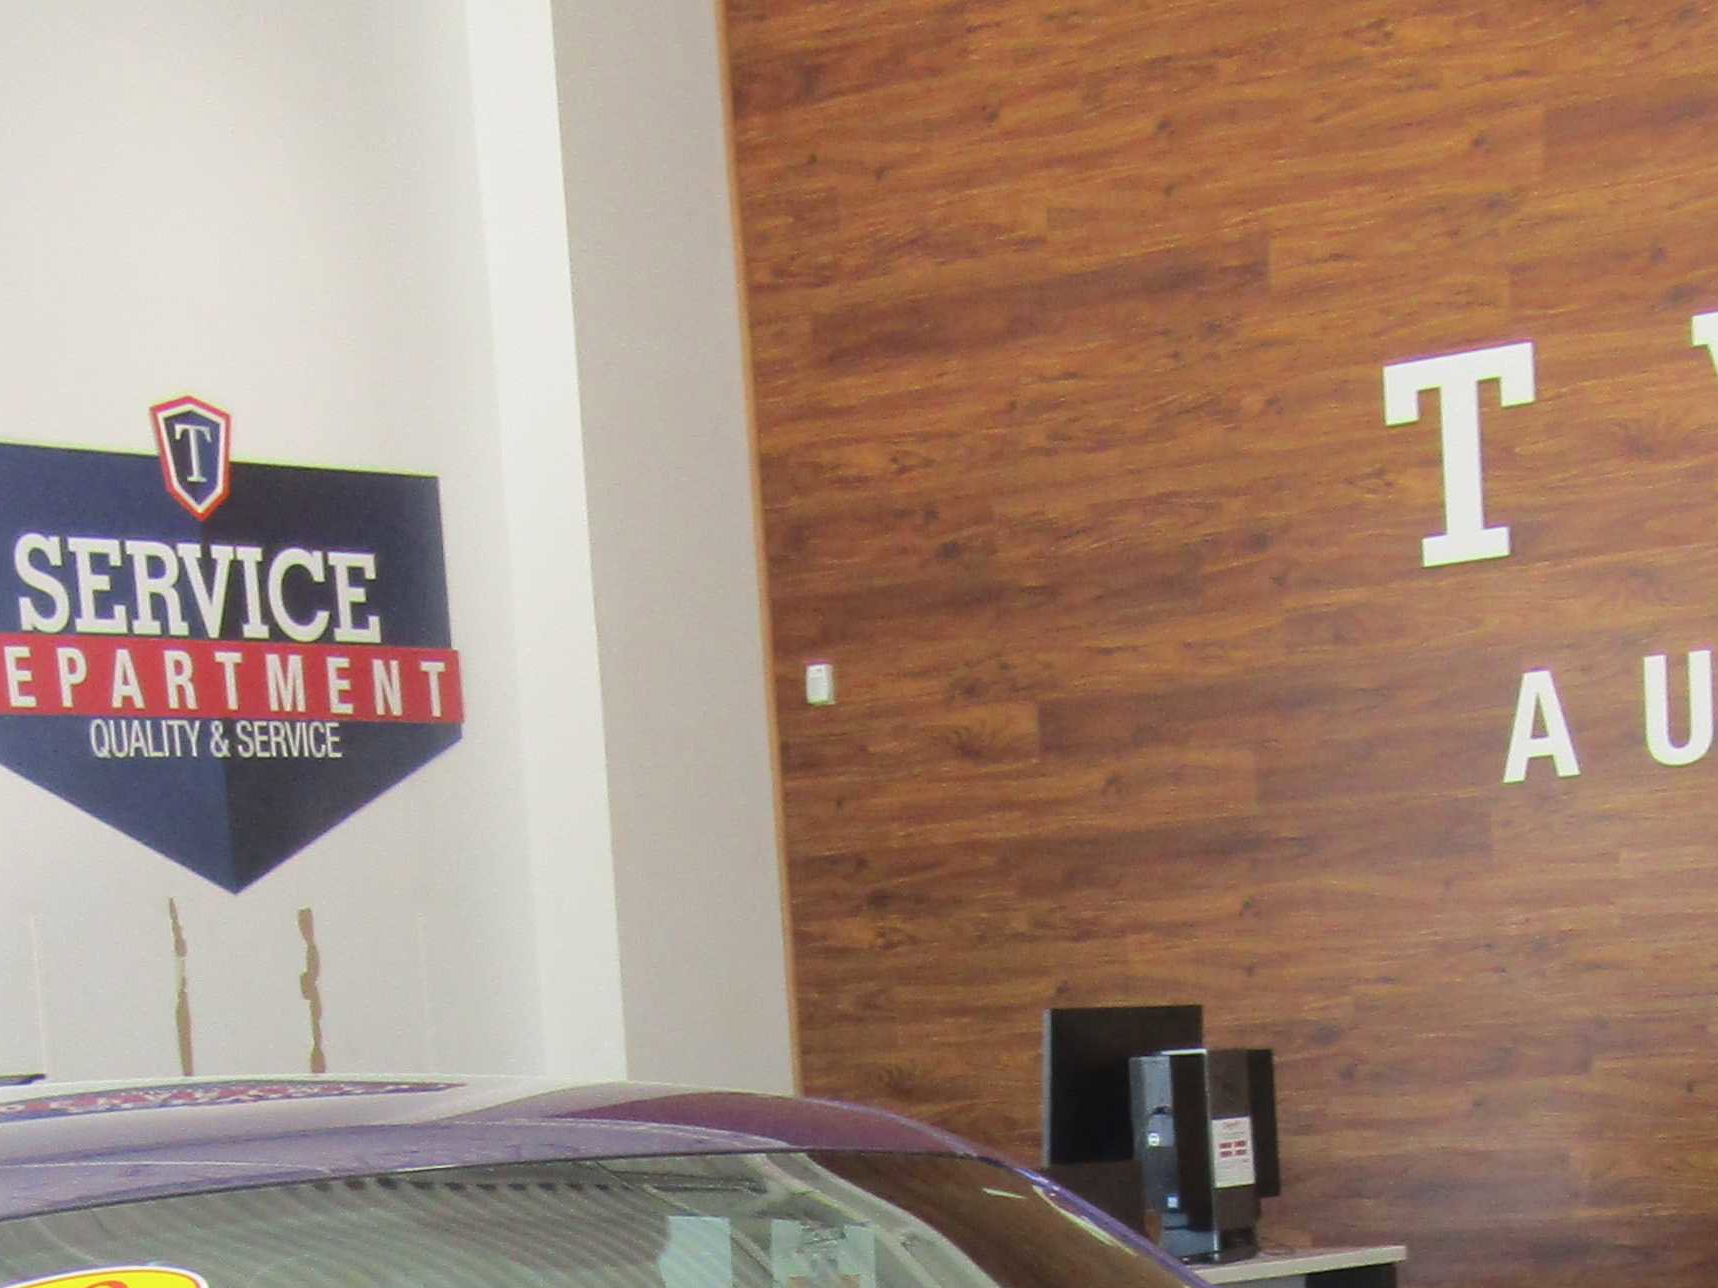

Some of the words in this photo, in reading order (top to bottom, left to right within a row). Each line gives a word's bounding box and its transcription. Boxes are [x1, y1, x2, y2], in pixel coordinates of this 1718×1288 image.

[173, 423, 212, 483] T
[13, 532, 381, 644] SERVICE
[89, 717, 202, 759] QUALITY
[209, 719, 231, 759] &
[236, 719, 343, 760] SERVICE
